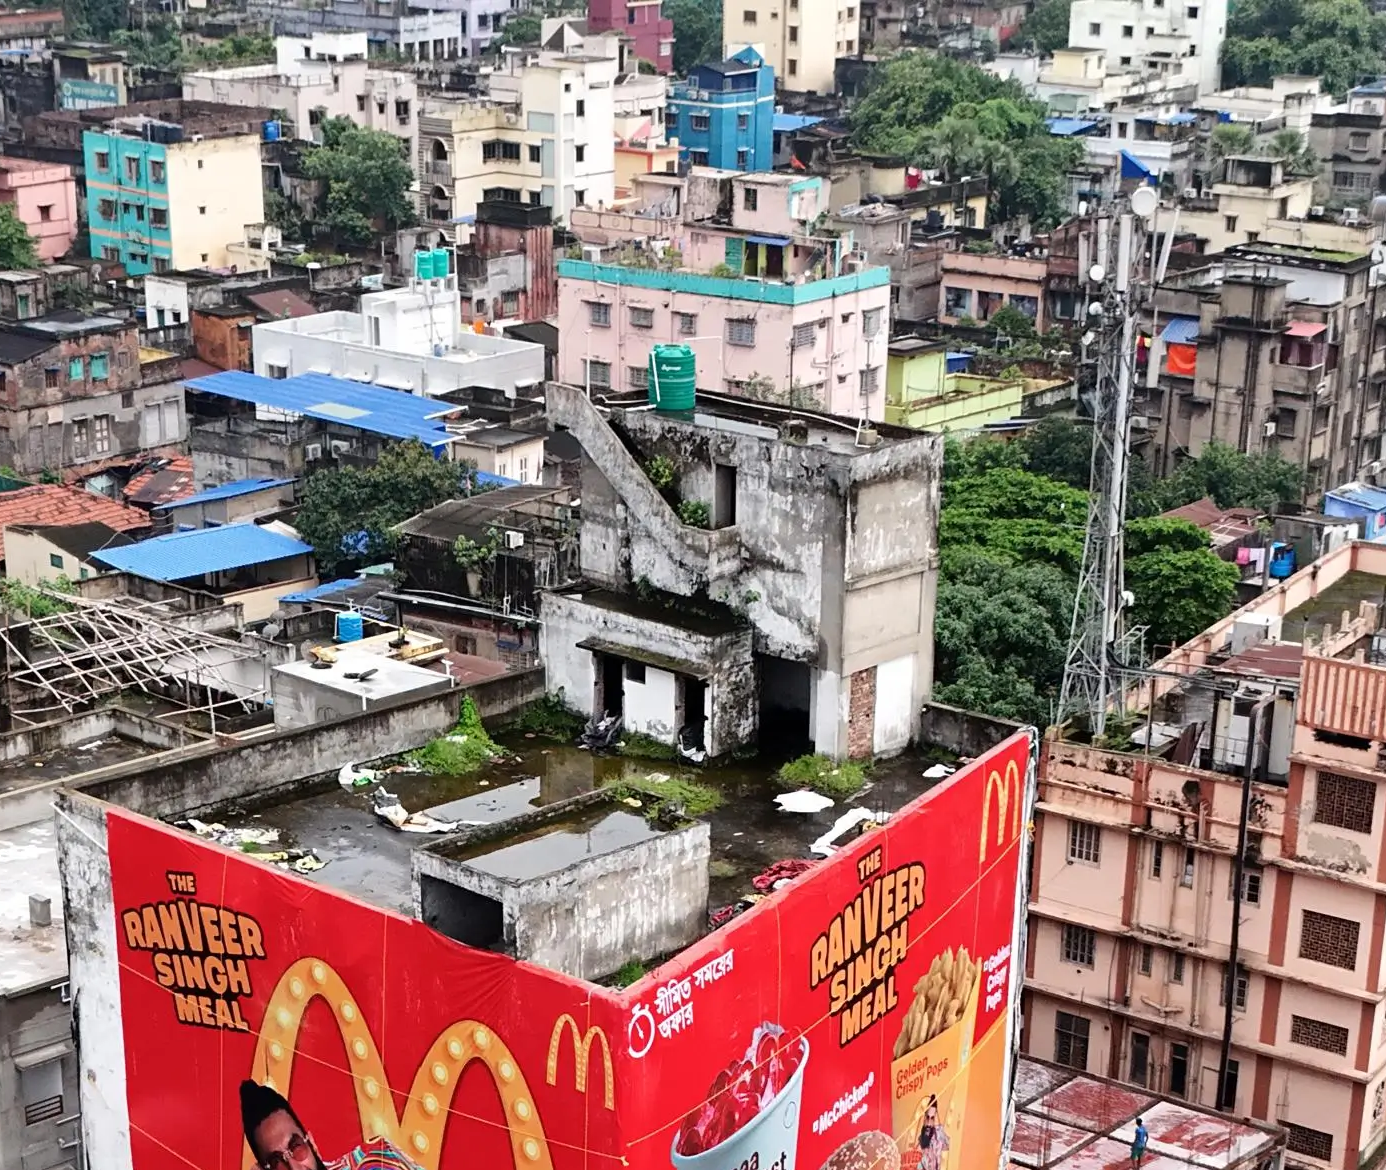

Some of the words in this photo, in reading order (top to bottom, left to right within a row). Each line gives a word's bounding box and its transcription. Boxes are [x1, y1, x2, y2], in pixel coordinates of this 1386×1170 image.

[167, 872, 196, 894] THE
[858, 848, 882, 881] THE
[123, 900, 266, 958] RANVEER
[810, 864, 925, 988] RANVEER
[153, 952, 252, 996] SINGH
[654, 977, 691, 1017] সীমিত
[692, 948, 735, 990] সময়ের
[829, 921, 908, 1014] SINGH
[175, 992, 248, 1031] MEAL
[658, 1001, 694, 1040] অফার
[840, 976, 897, 1045] MEAL
[896, 1075, 924, 1100] Crispy
[926, 1057, 949, 1082] Pops
[897, 1056, 929, 1084] Golden
